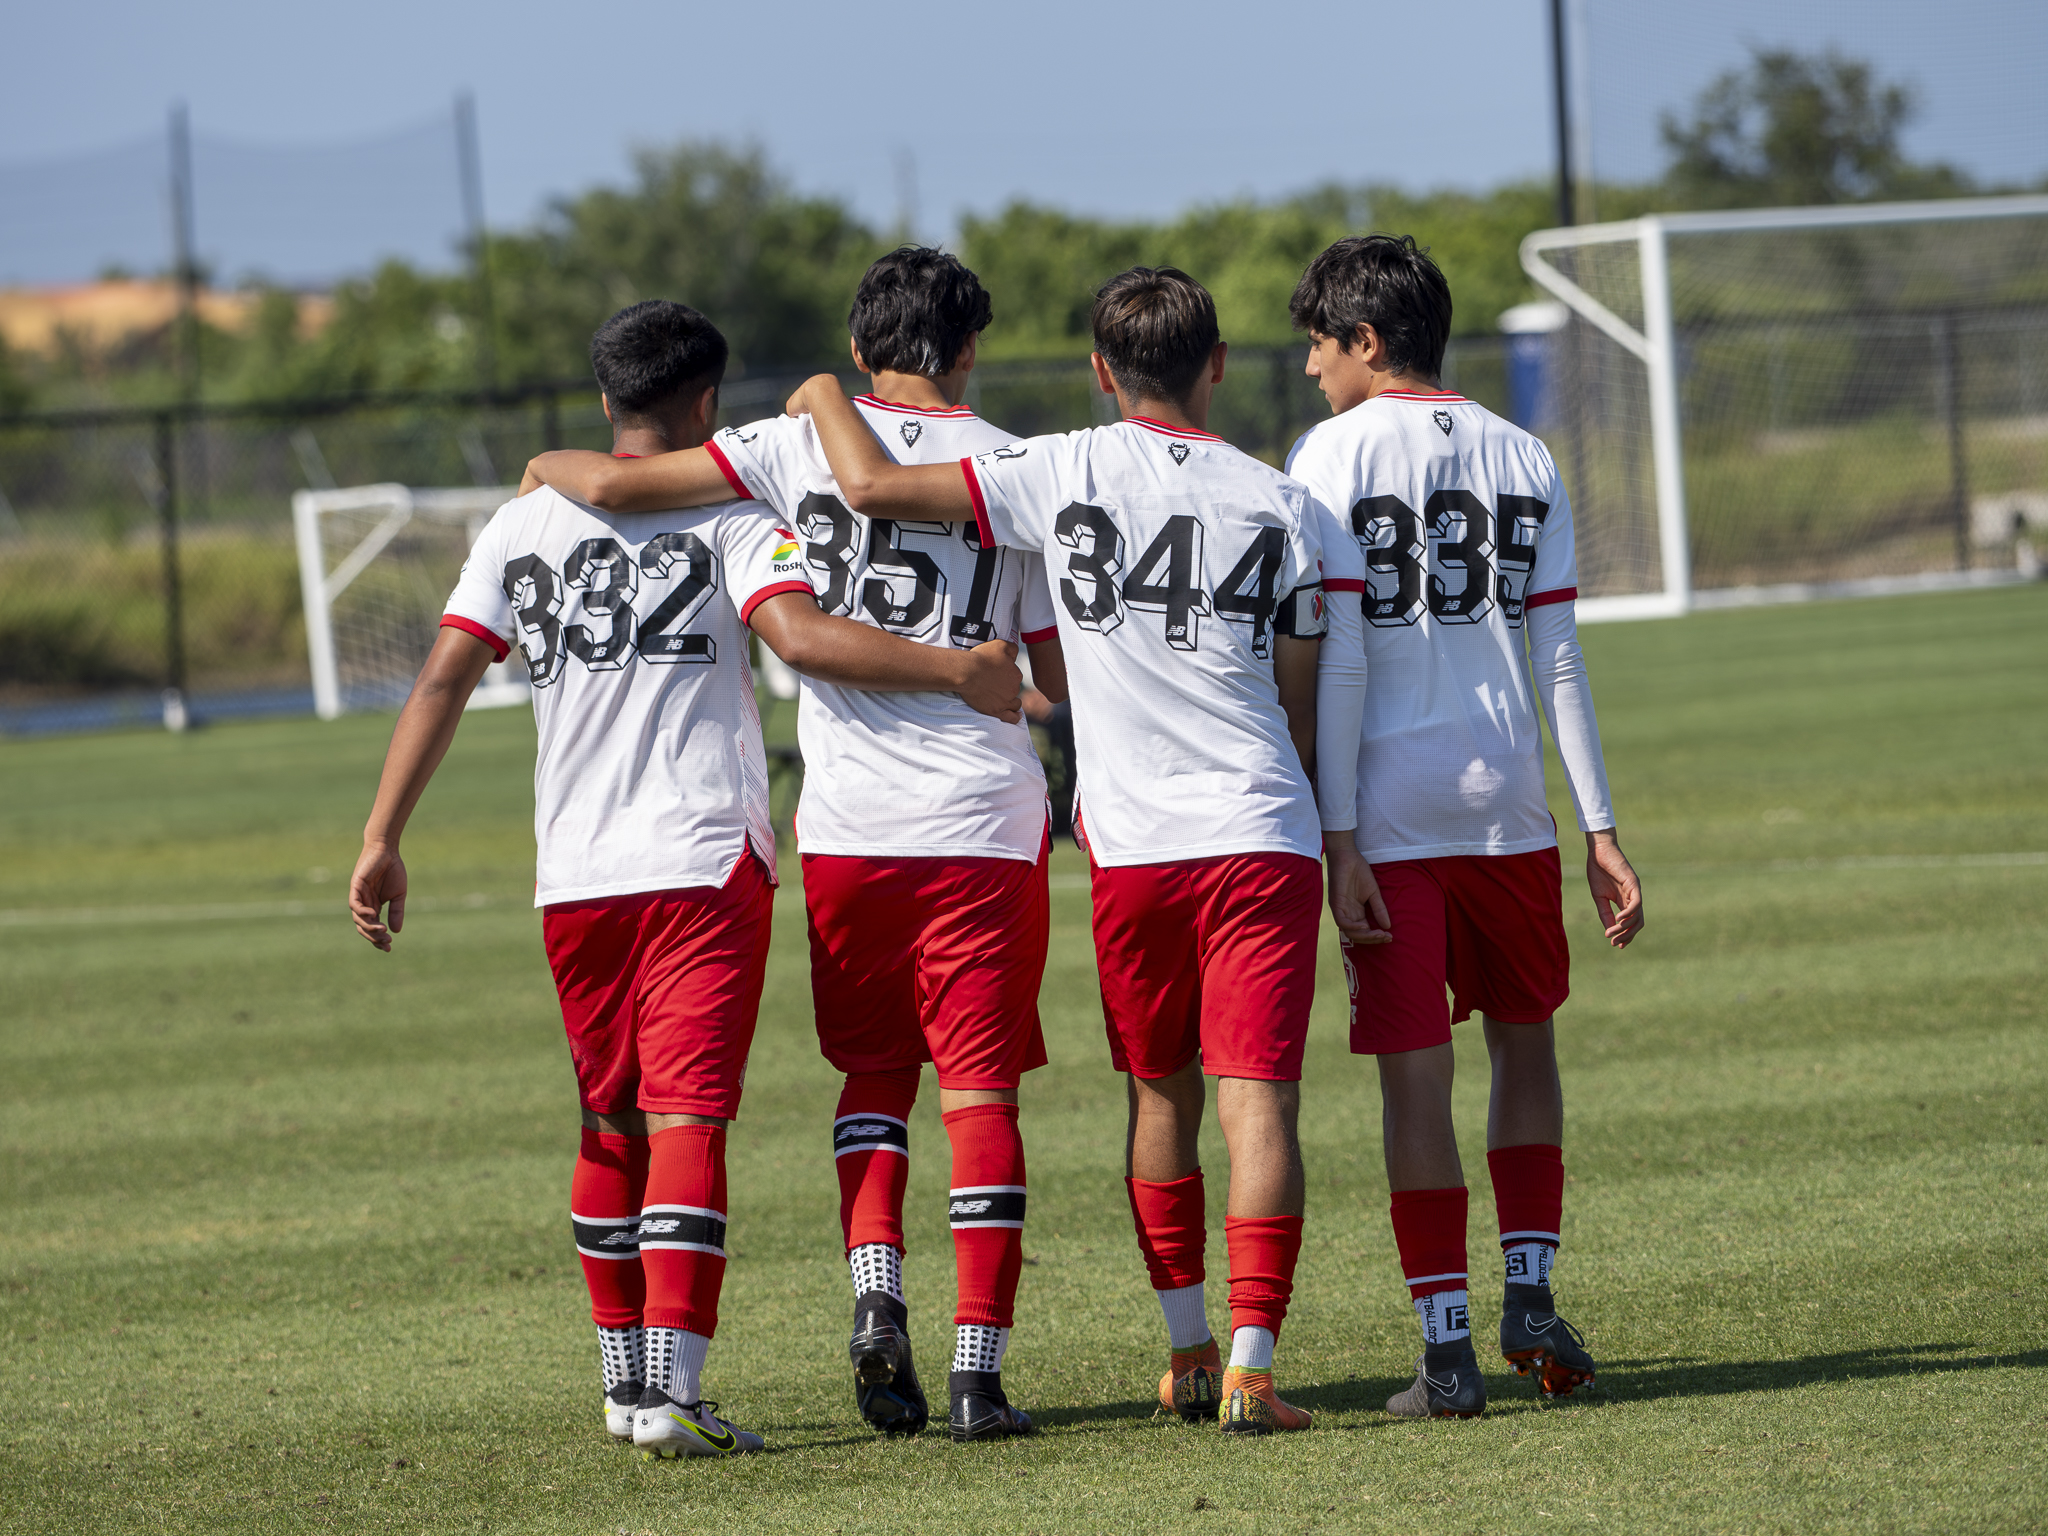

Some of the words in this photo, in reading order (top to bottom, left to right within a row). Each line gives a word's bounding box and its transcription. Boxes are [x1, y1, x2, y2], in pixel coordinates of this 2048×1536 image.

[503, 533, 718, 688] 332
[796, 490, 1007, 650] 351
[1054, 501, 1290, 660] 344
[1351, 490, 1550, 629] 335
[665, 639, 684, 650] NB
